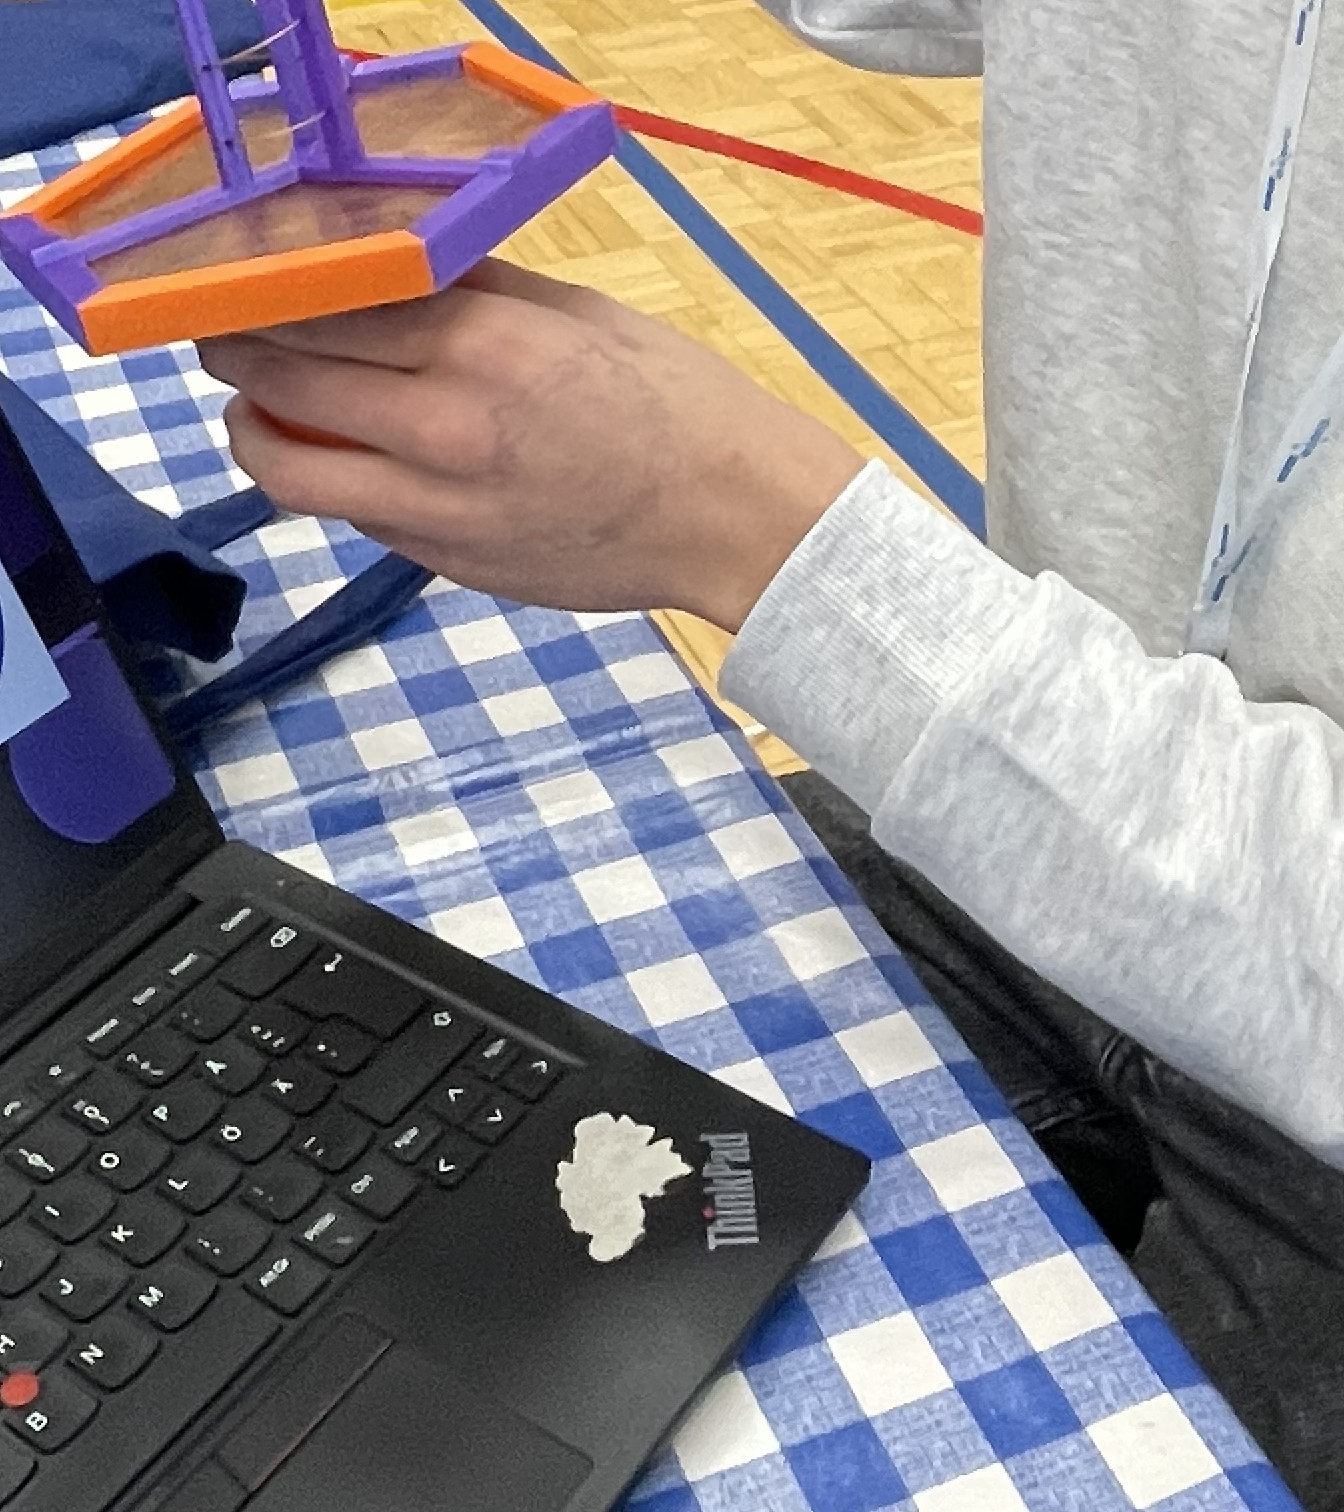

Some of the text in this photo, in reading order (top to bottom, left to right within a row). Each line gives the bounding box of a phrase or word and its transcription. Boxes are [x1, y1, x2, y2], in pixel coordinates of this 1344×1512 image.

[100, 1153, 120, 1169] O
[699, 1132, 760, 1252] ThinkPad
[58, 1278, 74, 1296] J
[110, 1224, 134, 1242] K
[168, 1177, 189, 1191] L
[25, 1410, 49, 1432] B
[79, 1343, 104, 1366] N
[138, 1286, 164, 1308] M
